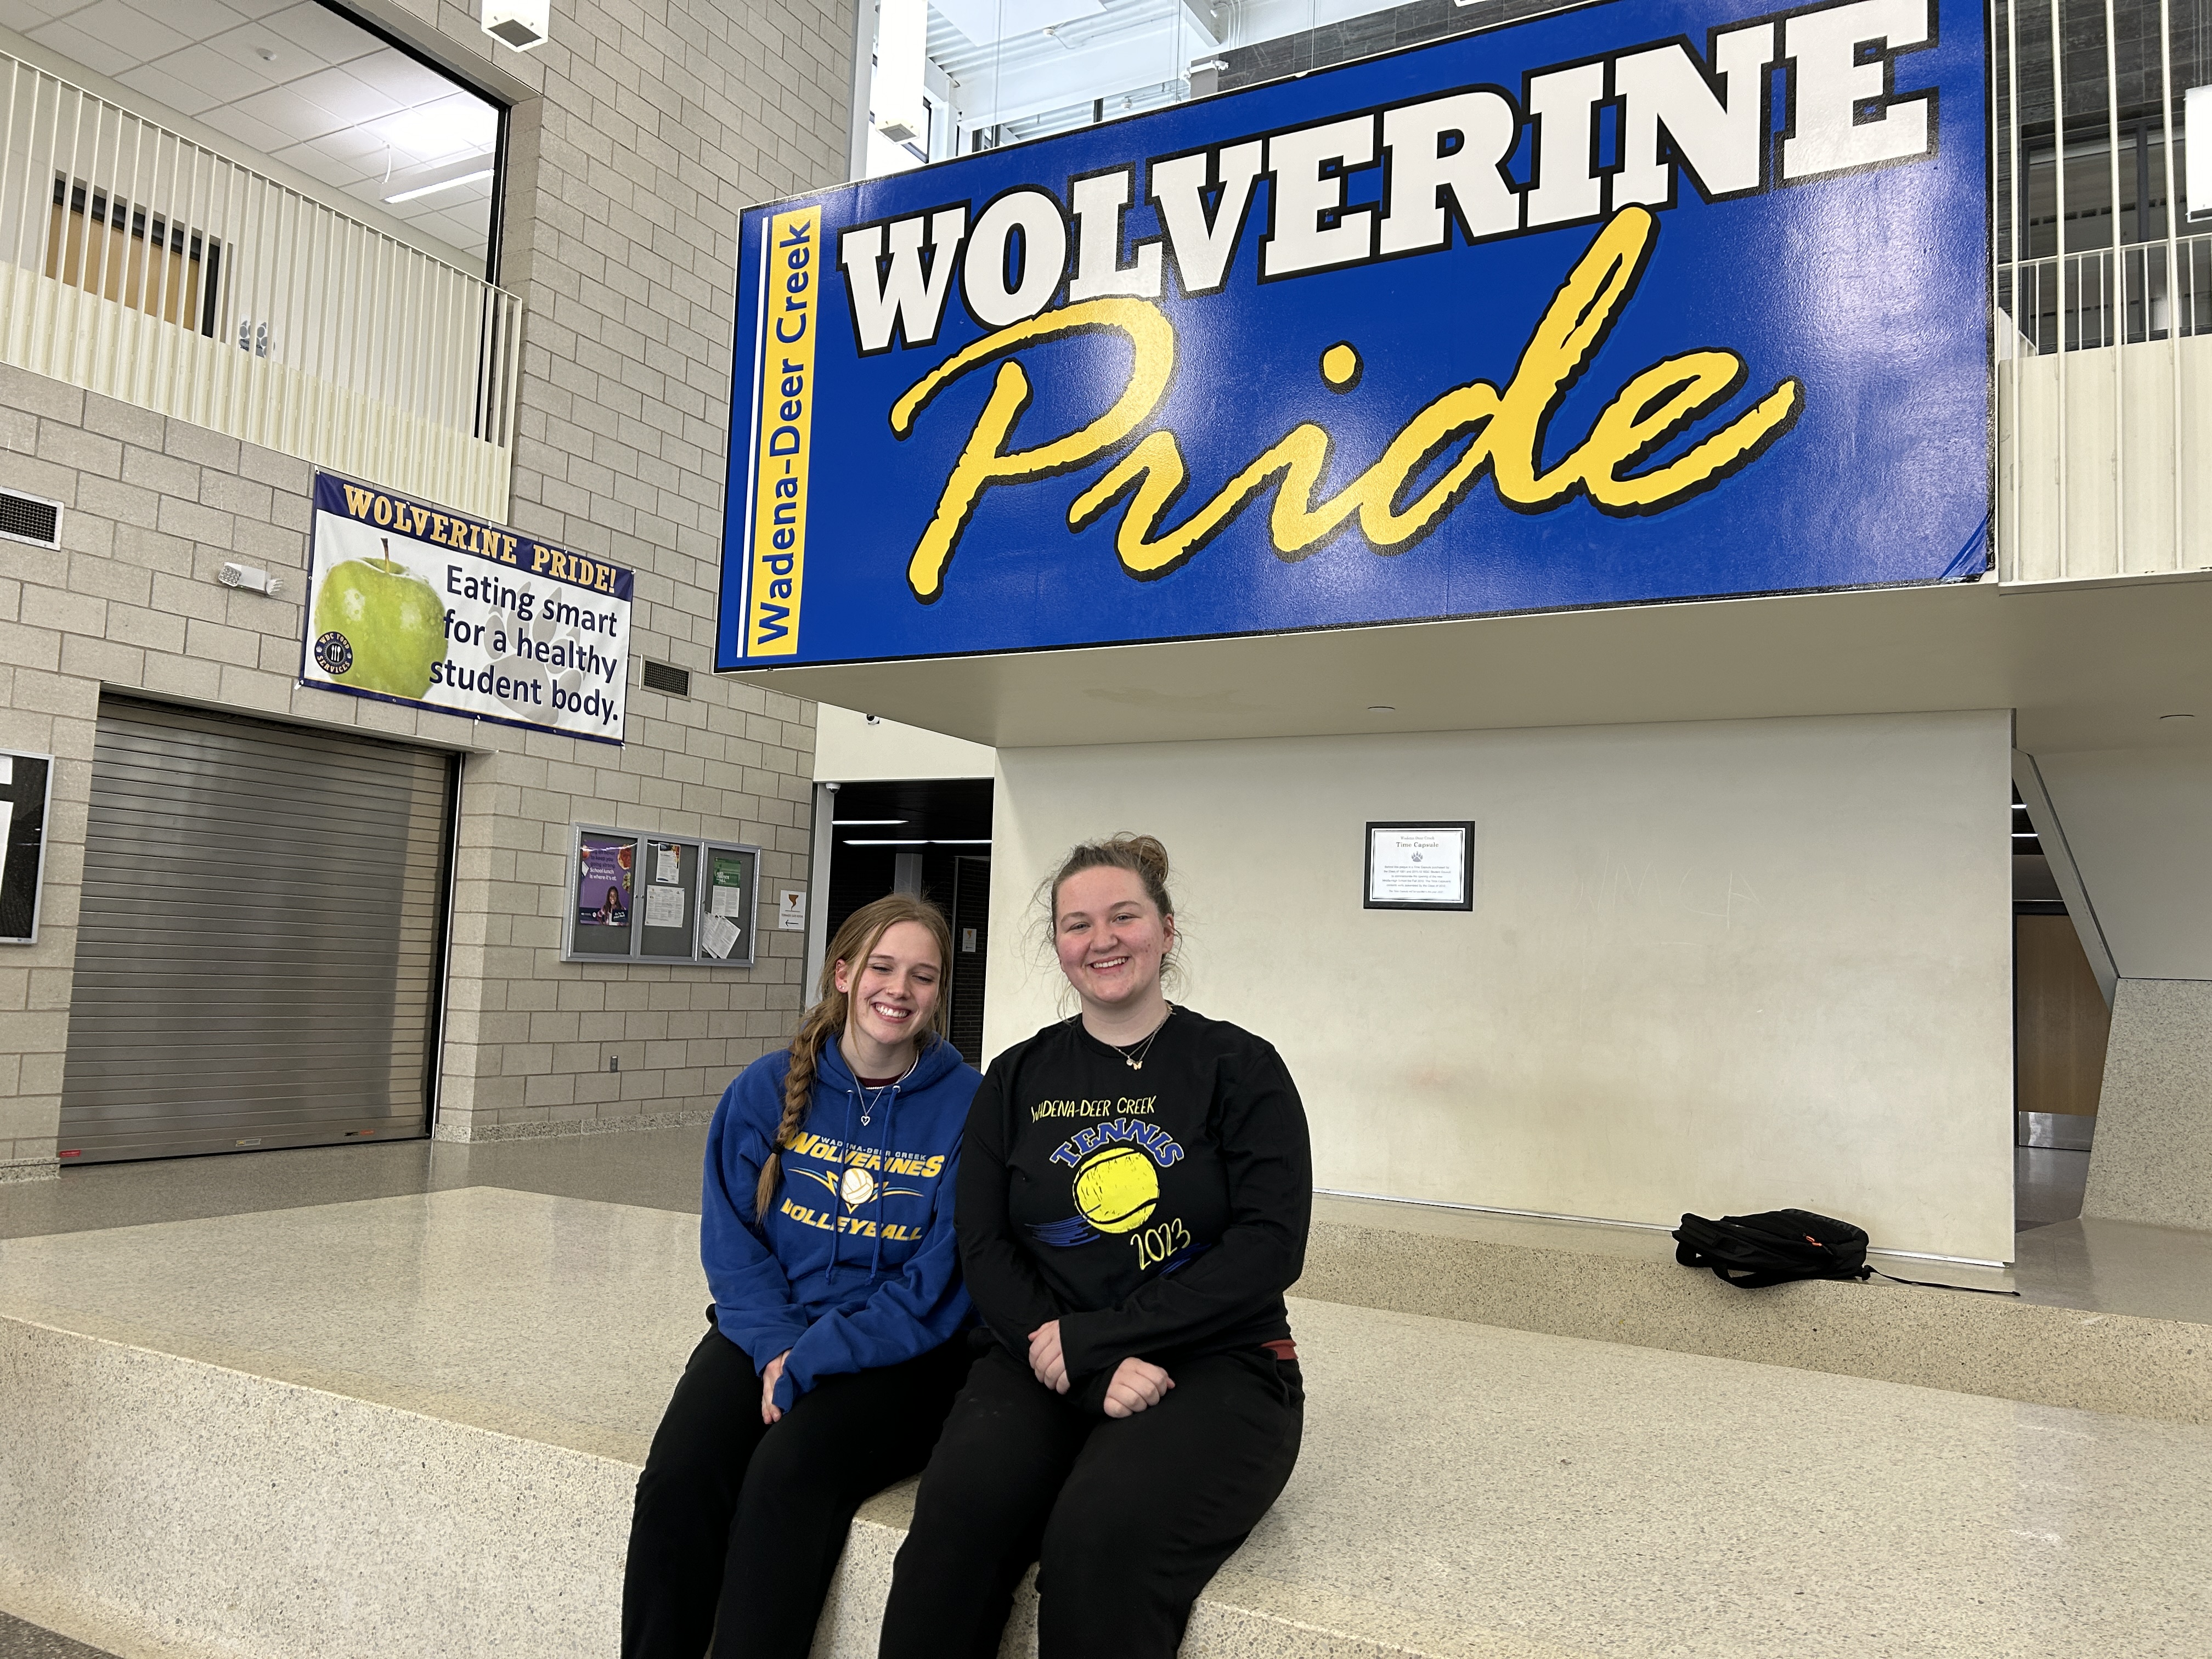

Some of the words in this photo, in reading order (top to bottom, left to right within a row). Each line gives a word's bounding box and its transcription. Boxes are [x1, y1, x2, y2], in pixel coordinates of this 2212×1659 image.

[839, 0, 1932, 354] WOLVERINE
[776, 219, 810, 345] Creek
[889, 206, 1798, 599] Pride
[757, 357, 804, 645] Wadena-Deer
[343, 484, 517, 564] WOLVERINE
[531, 544, 617, 593] PRIDE!
[447, 565, 535, 621] Eating
[543, 599, 617, 637] smart
[317, 655, 350, 673] SERVICES
[319, 633, 334, 644] WDC
[336, 633, 349, 649] FOOD
[443, 609, 485, 646] for
[493, 629, 507, 653] a
[517, 628, 617, 684] healthy
[429, 659, 542, 705] student
[552, 679, 618, 725] body.
[1117, 1095, 1156, 1114] CREEK
[784, 1131, 945, 1178] WOLVERINES
[895, 1151, 927, 1161] CREEK
[1049, 1117, 1184, 1168] TENNIS
[1130, 1217, 1191, 1271] 2023
